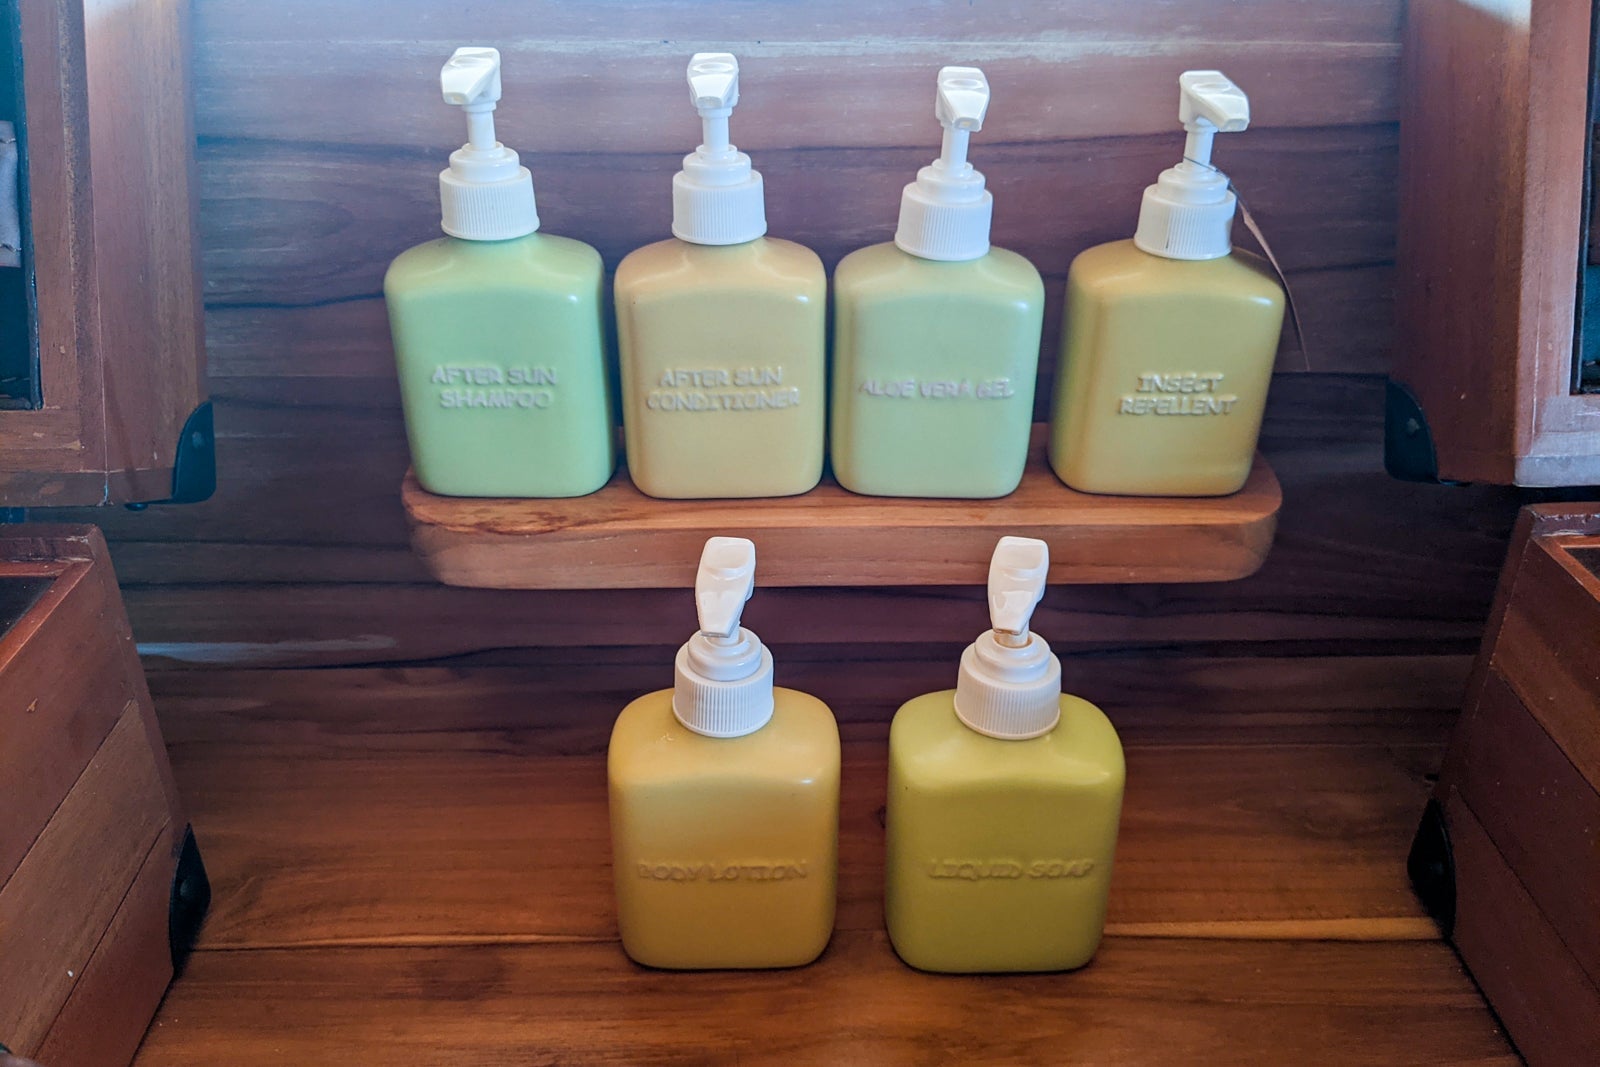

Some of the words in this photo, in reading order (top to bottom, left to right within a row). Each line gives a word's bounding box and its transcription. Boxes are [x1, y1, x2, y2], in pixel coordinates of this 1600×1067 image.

[431, 365, 503, 385] AFTER
[507, 366, 557, 385] SUN
[660, 368, 729, 388] AFTER
[733, 365, 783, 387] SUN
[1136, 372, 1224, 393] INSECT
[440, 389, 553, 409] SHAMPOO
[647, 387, 800, 411] CONDITIONER
[860, 378, 915, 399] ALOE
[919, 379, 971, 399] VERA
[976, 377, 1015, 400] GEL
[1119, 394, 1237, 415] REPELLENT
[637, 860, 703, 883] BODY
[708, 860, 807, 882] LOTION
[928, 859, 1022, 881] LIQUID
[1027, 858, 1094, 880] SOAP
